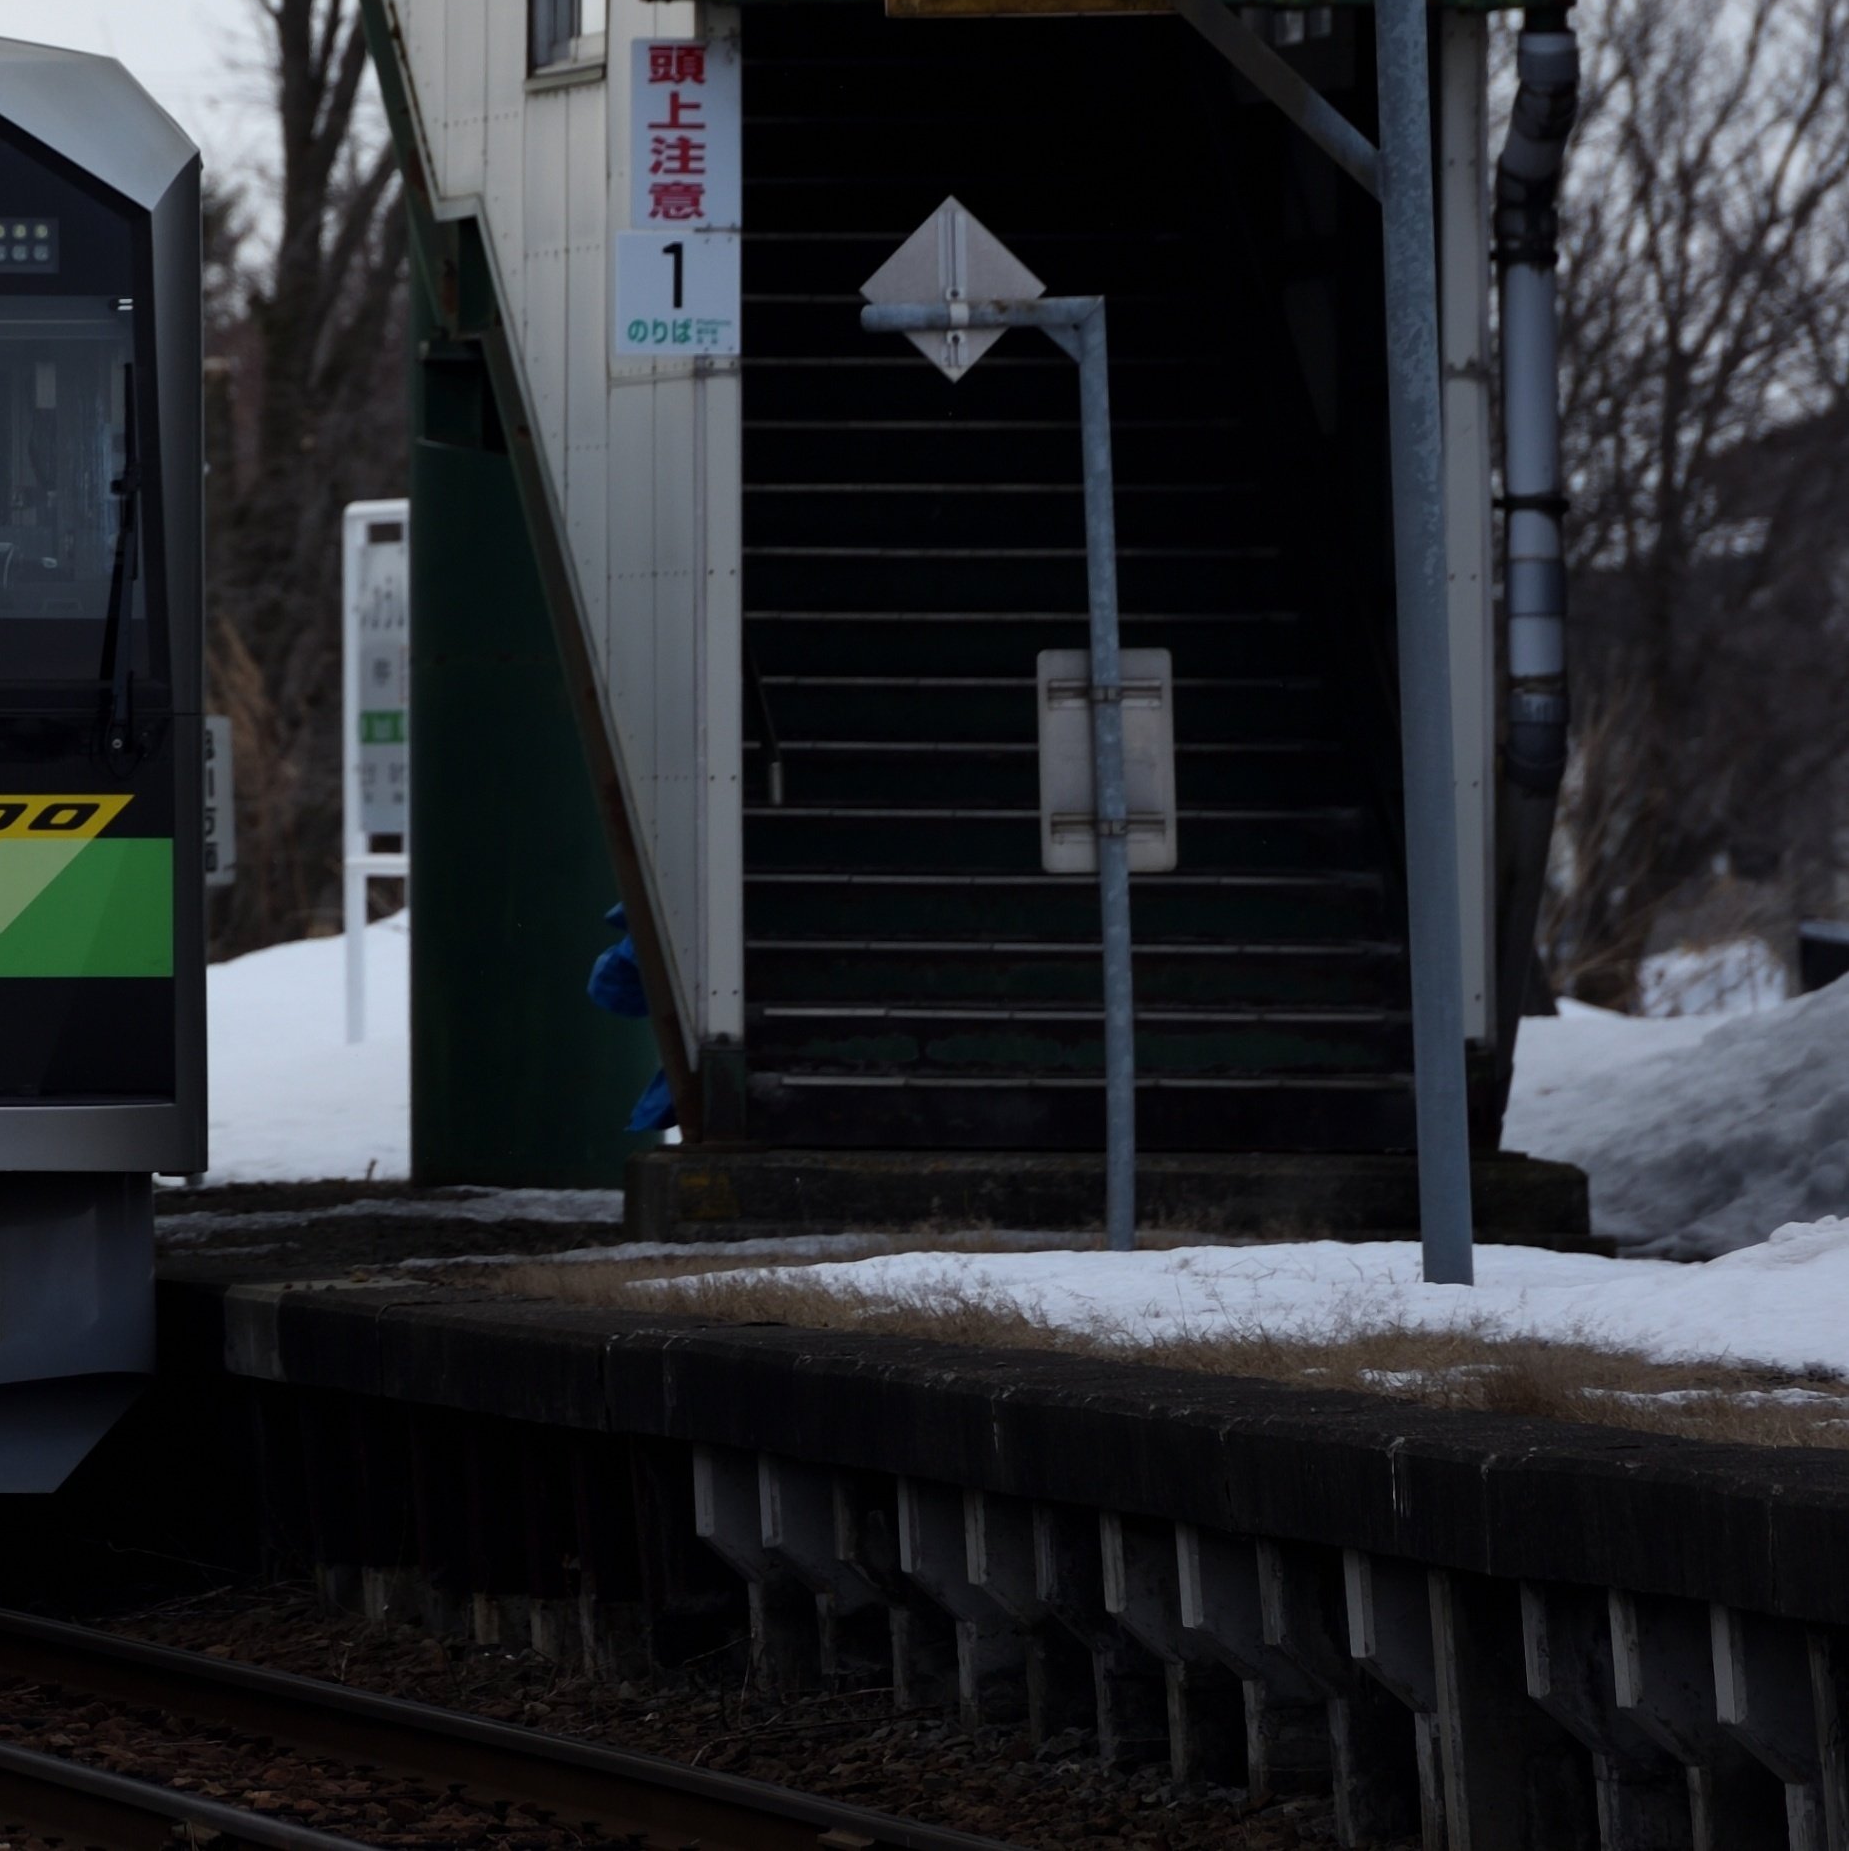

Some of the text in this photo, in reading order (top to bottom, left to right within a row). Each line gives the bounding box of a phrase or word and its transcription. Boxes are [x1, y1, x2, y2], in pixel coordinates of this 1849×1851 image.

[647, 45, 706, 221] 頭上注意
[662, 241, 683, 309] 1
[627, 318, 692, 344] のりば
